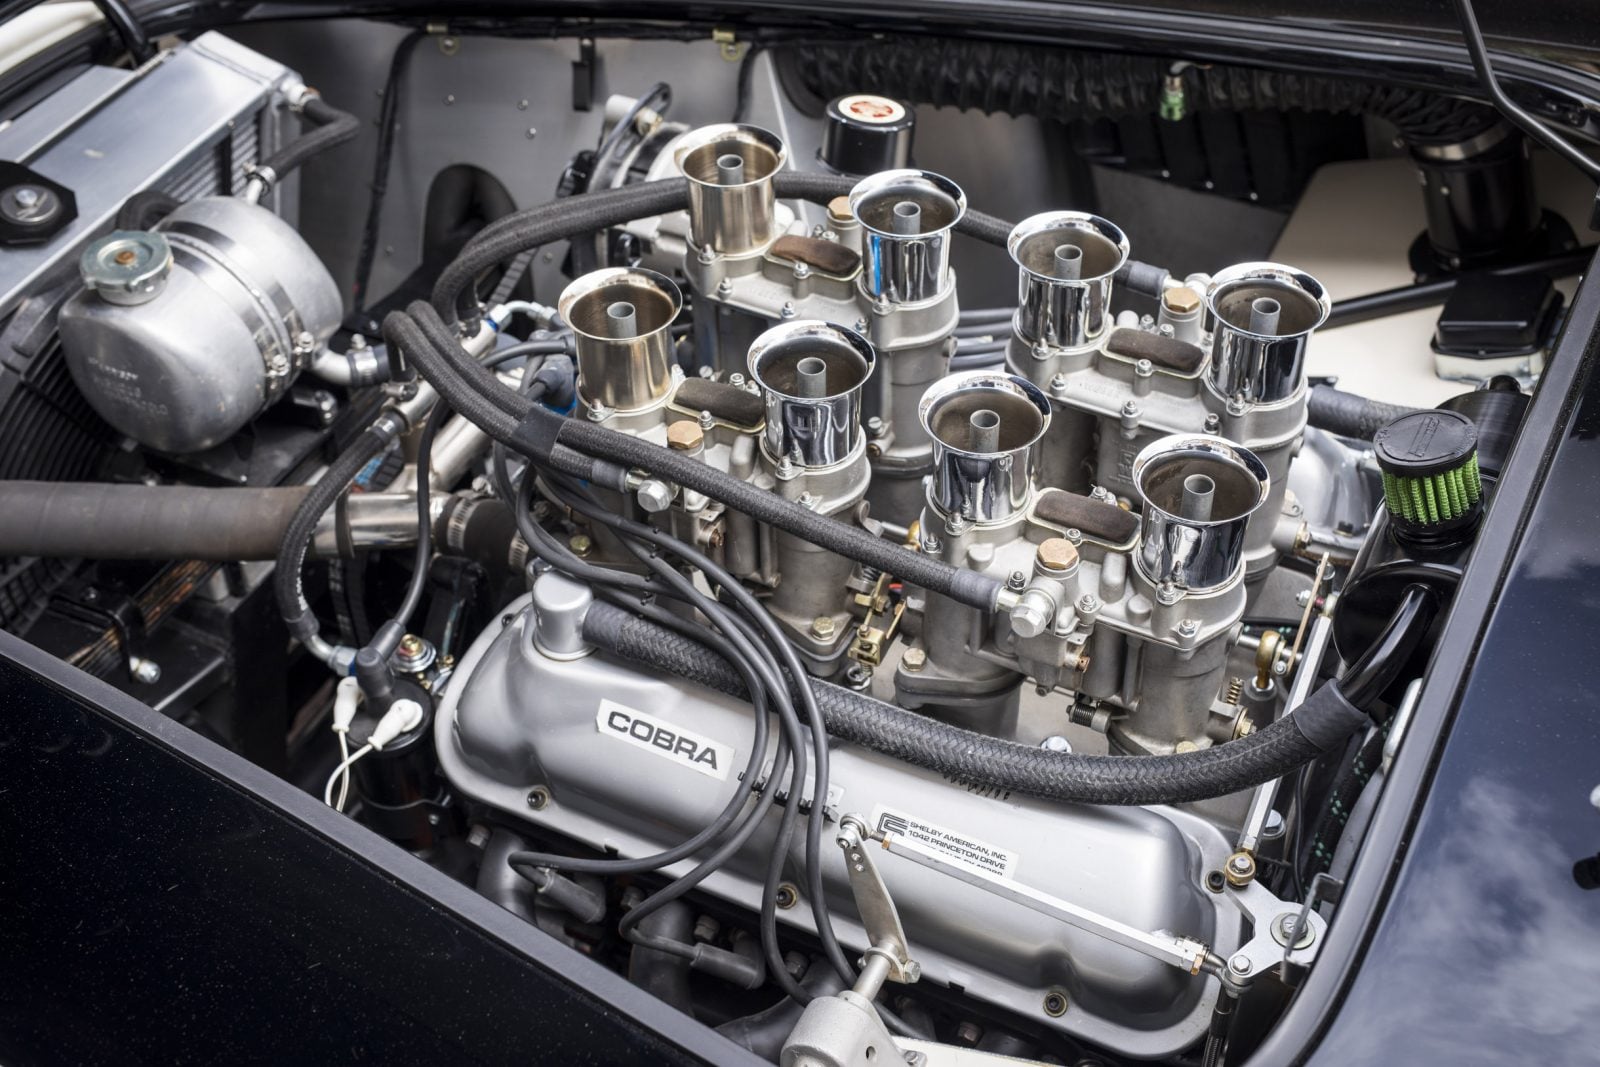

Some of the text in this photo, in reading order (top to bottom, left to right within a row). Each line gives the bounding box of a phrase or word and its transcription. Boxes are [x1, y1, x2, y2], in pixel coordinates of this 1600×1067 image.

[607, 711, 718, 770] COBRA
[908, 830, 930, 842] 1042
[930, 838, 980, 861] PRINCETON
[979, 856, 1006, 870] DRIVE
[910, 821, 943, 837] SHELBY
[943, 834, 990, 857] AMERICAN,
[990, 850, 1008, 862] INC.
